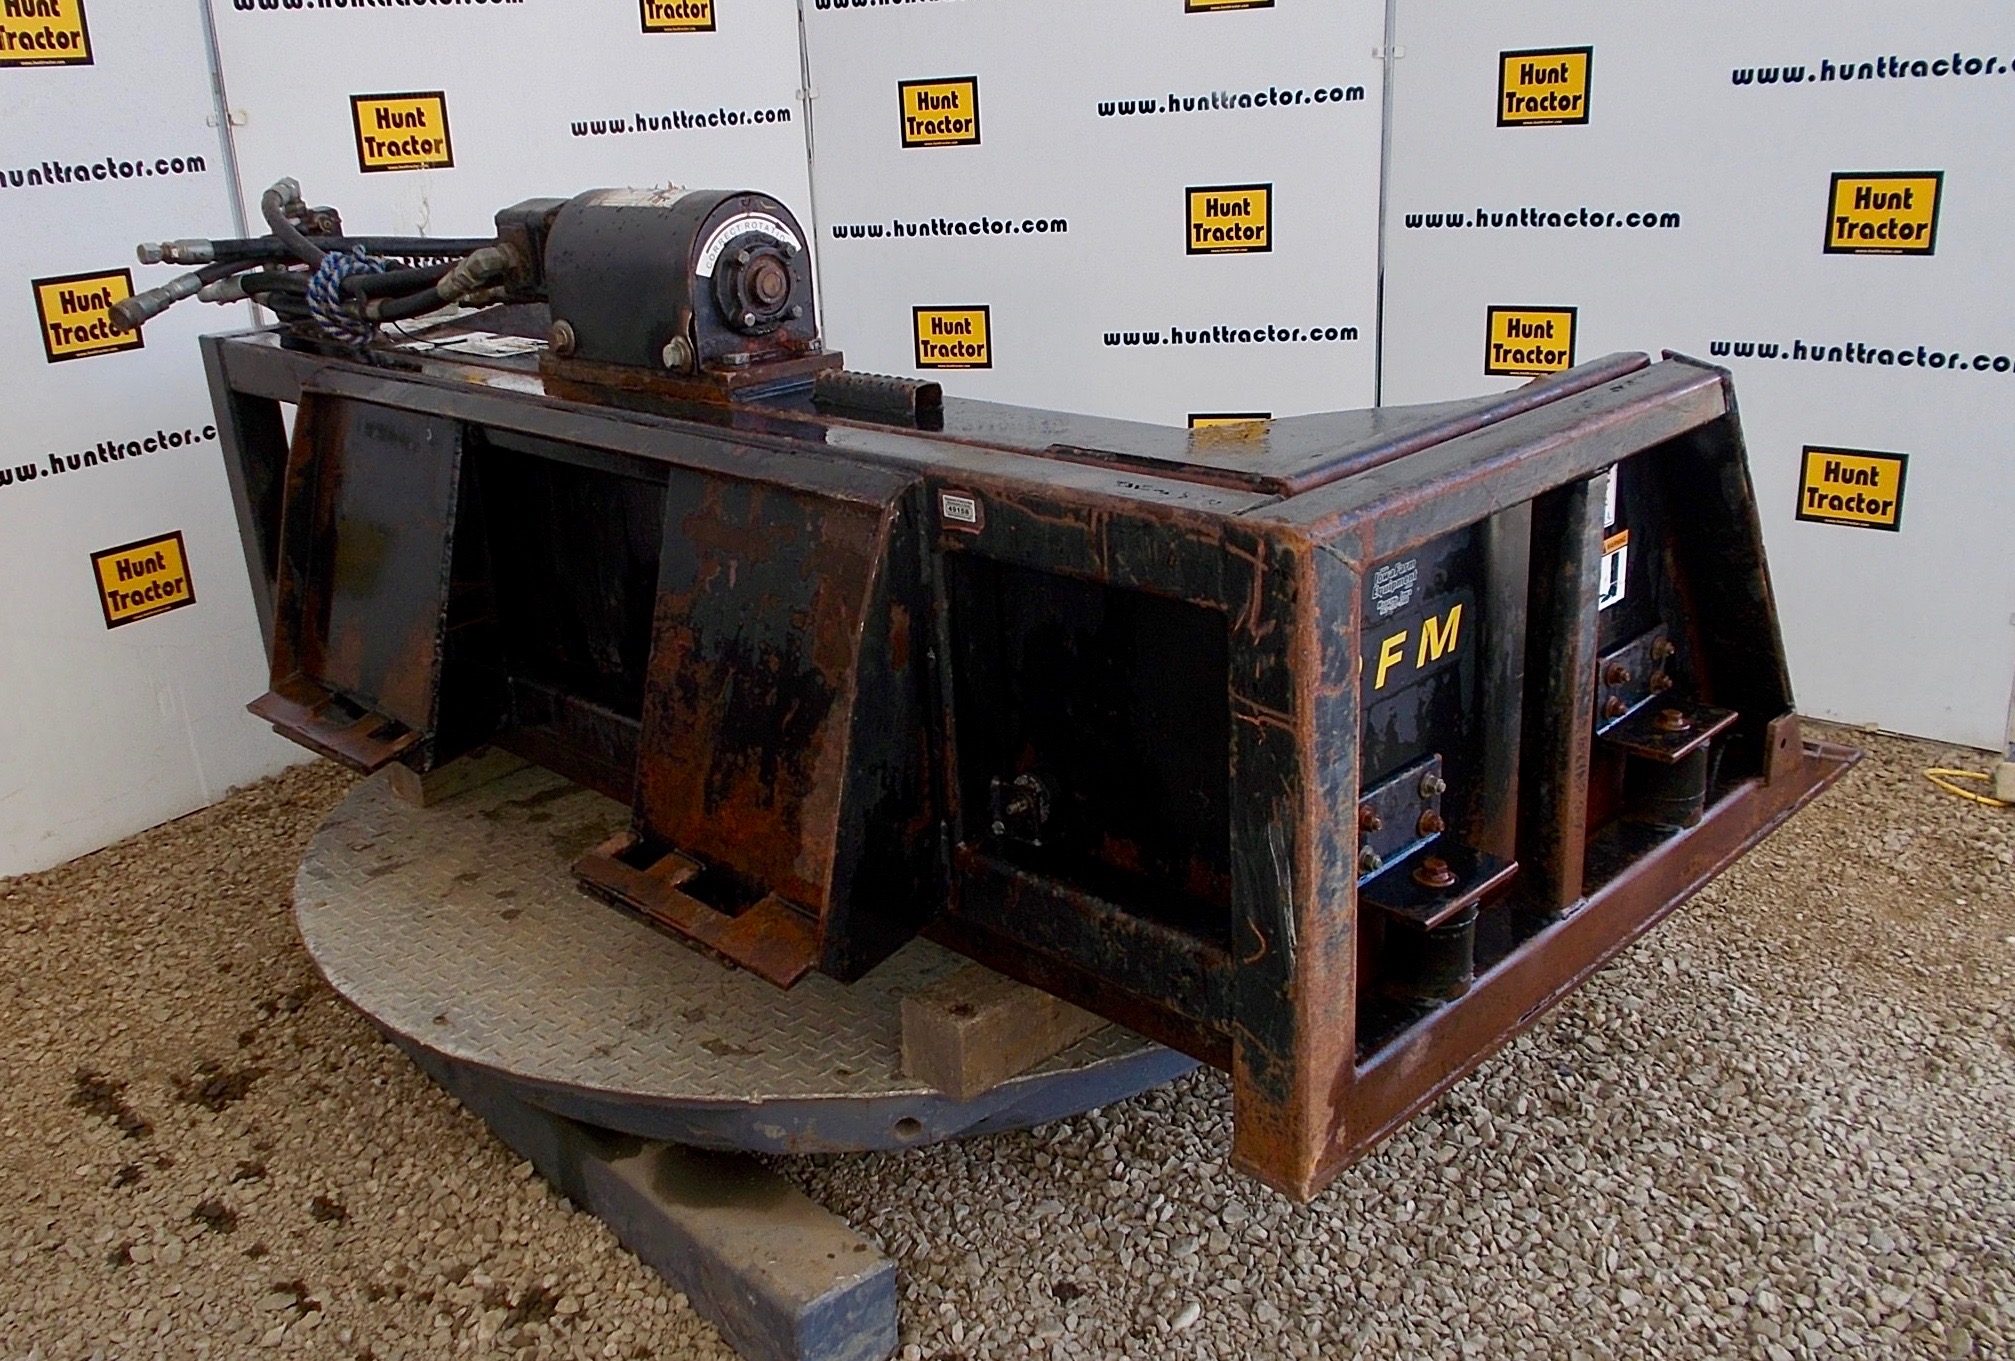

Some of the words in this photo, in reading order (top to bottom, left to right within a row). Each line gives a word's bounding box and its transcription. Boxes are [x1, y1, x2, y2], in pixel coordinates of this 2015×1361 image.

[4, 0, 61, 17] Hunt
[645, 0, 708, 19] Tractor
[1520, 62, 1569, 85] Hunt
[1732, 53, 2015, 85] www.hunttractor.
[916, 90, 959, 111] Hunt
[1097, 86, 1365, 117] www.hunttractor.com
[1505, 91, 1582, 113] Tractor
[375, 107, 427, 129] Hunt
[571, 108, 791, 137] www.hunttractor.com
[906, 115, 973, 135] Tractor
[364, 135, 443, 158] Tractor
[1206, 197, 1251, 217] Hunt
[1854, 186, 1914, 210] Hunt
[832, 216, 1068, 239] www.hunttractor.com
[1405, 207, 1681, 229] www.hunttractor.com
[1836, 216, 1929, 240] Tractor
[1193, 222, 1264, 242] Tractor
[706, 223, 742, 269] CORRECT
[59, 287, 113, 315] Hunt
[49, 317, 129, 346] Tracto
[931, 317, 972, 335] Hunt
[1103, 324, 1358, 346] www.hunttractor.com
[1507, 318, 1554, 339] Hunt
[921, 340, 984, 357] Tractor
[1493, 343, 1567, 365] Tractor
[1710, 339, 2015, 373] www.hunttractor.co
[1824, 460, 1880, 487] Hunt
[1807, 486, 1893, 516] Tractor
[115, 550, 166, 582] Hunt
[107, 577, 184, 612] Tractor
[1359, 603, 1462, 690] FM
